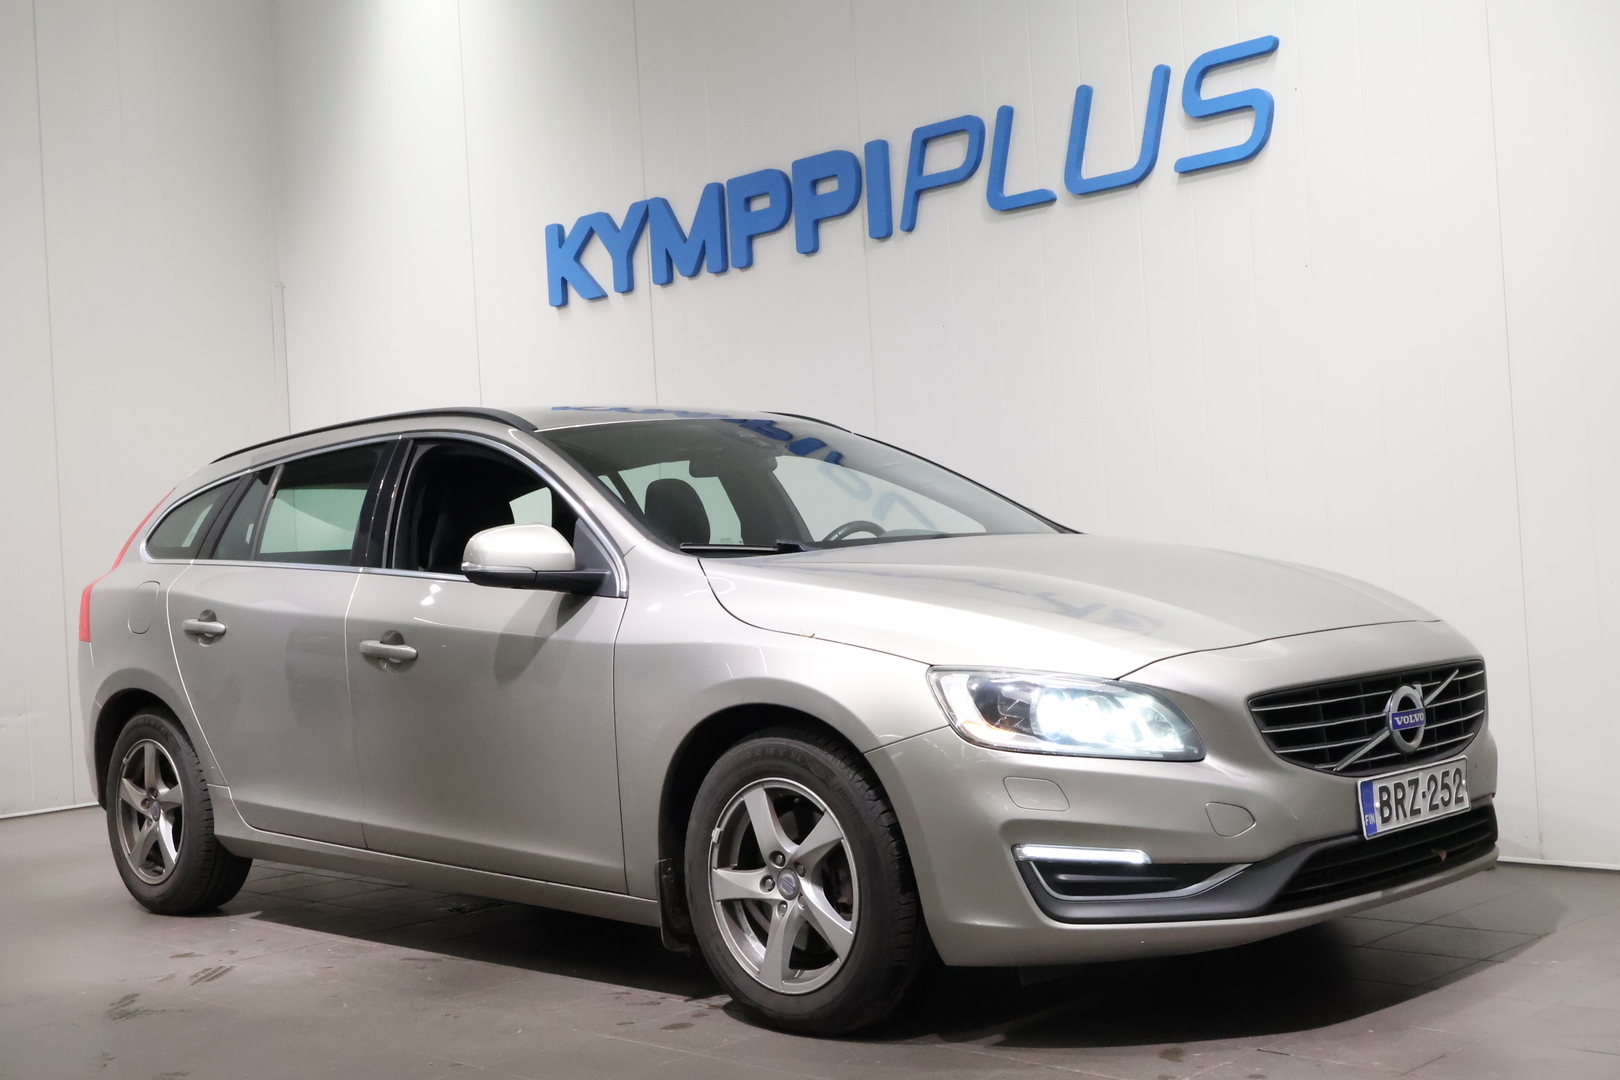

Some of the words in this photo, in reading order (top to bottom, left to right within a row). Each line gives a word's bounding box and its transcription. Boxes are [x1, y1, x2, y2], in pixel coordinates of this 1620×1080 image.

[545, 35, 1280, 307] KYMPPIPLUS
[1394, 711, 1425, 726] VOLVO
[836, 787, 858, 816] point
[1378, 767, 1464, 825] BRZ-252
[1364, 812, 1377, 827] FIN
